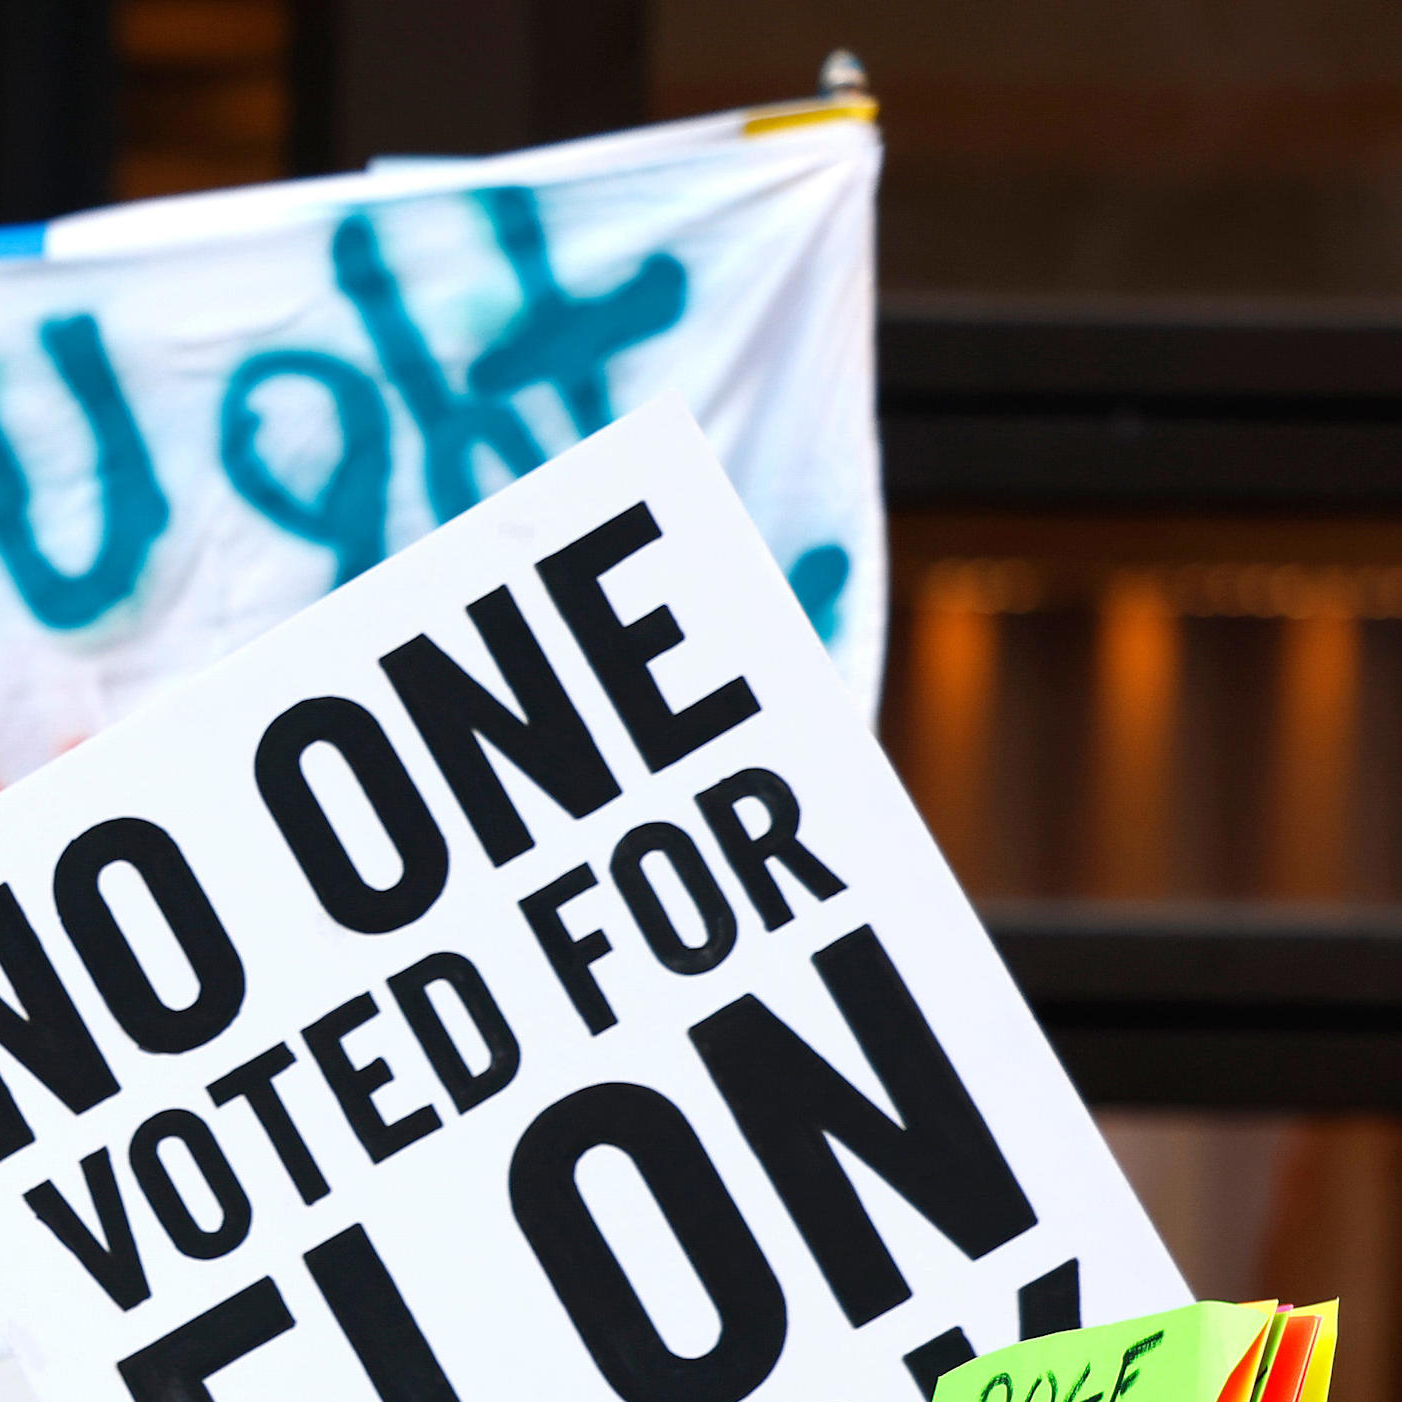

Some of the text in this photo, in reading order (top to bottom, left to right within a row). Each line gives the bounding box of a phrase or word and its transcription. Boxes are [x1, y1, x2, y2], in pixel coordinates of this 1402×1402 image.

[253, 500, 762, 935] ONE
[23, 950, 523, 1312] VOTED
[518, 766, 848, 1037] FOR
